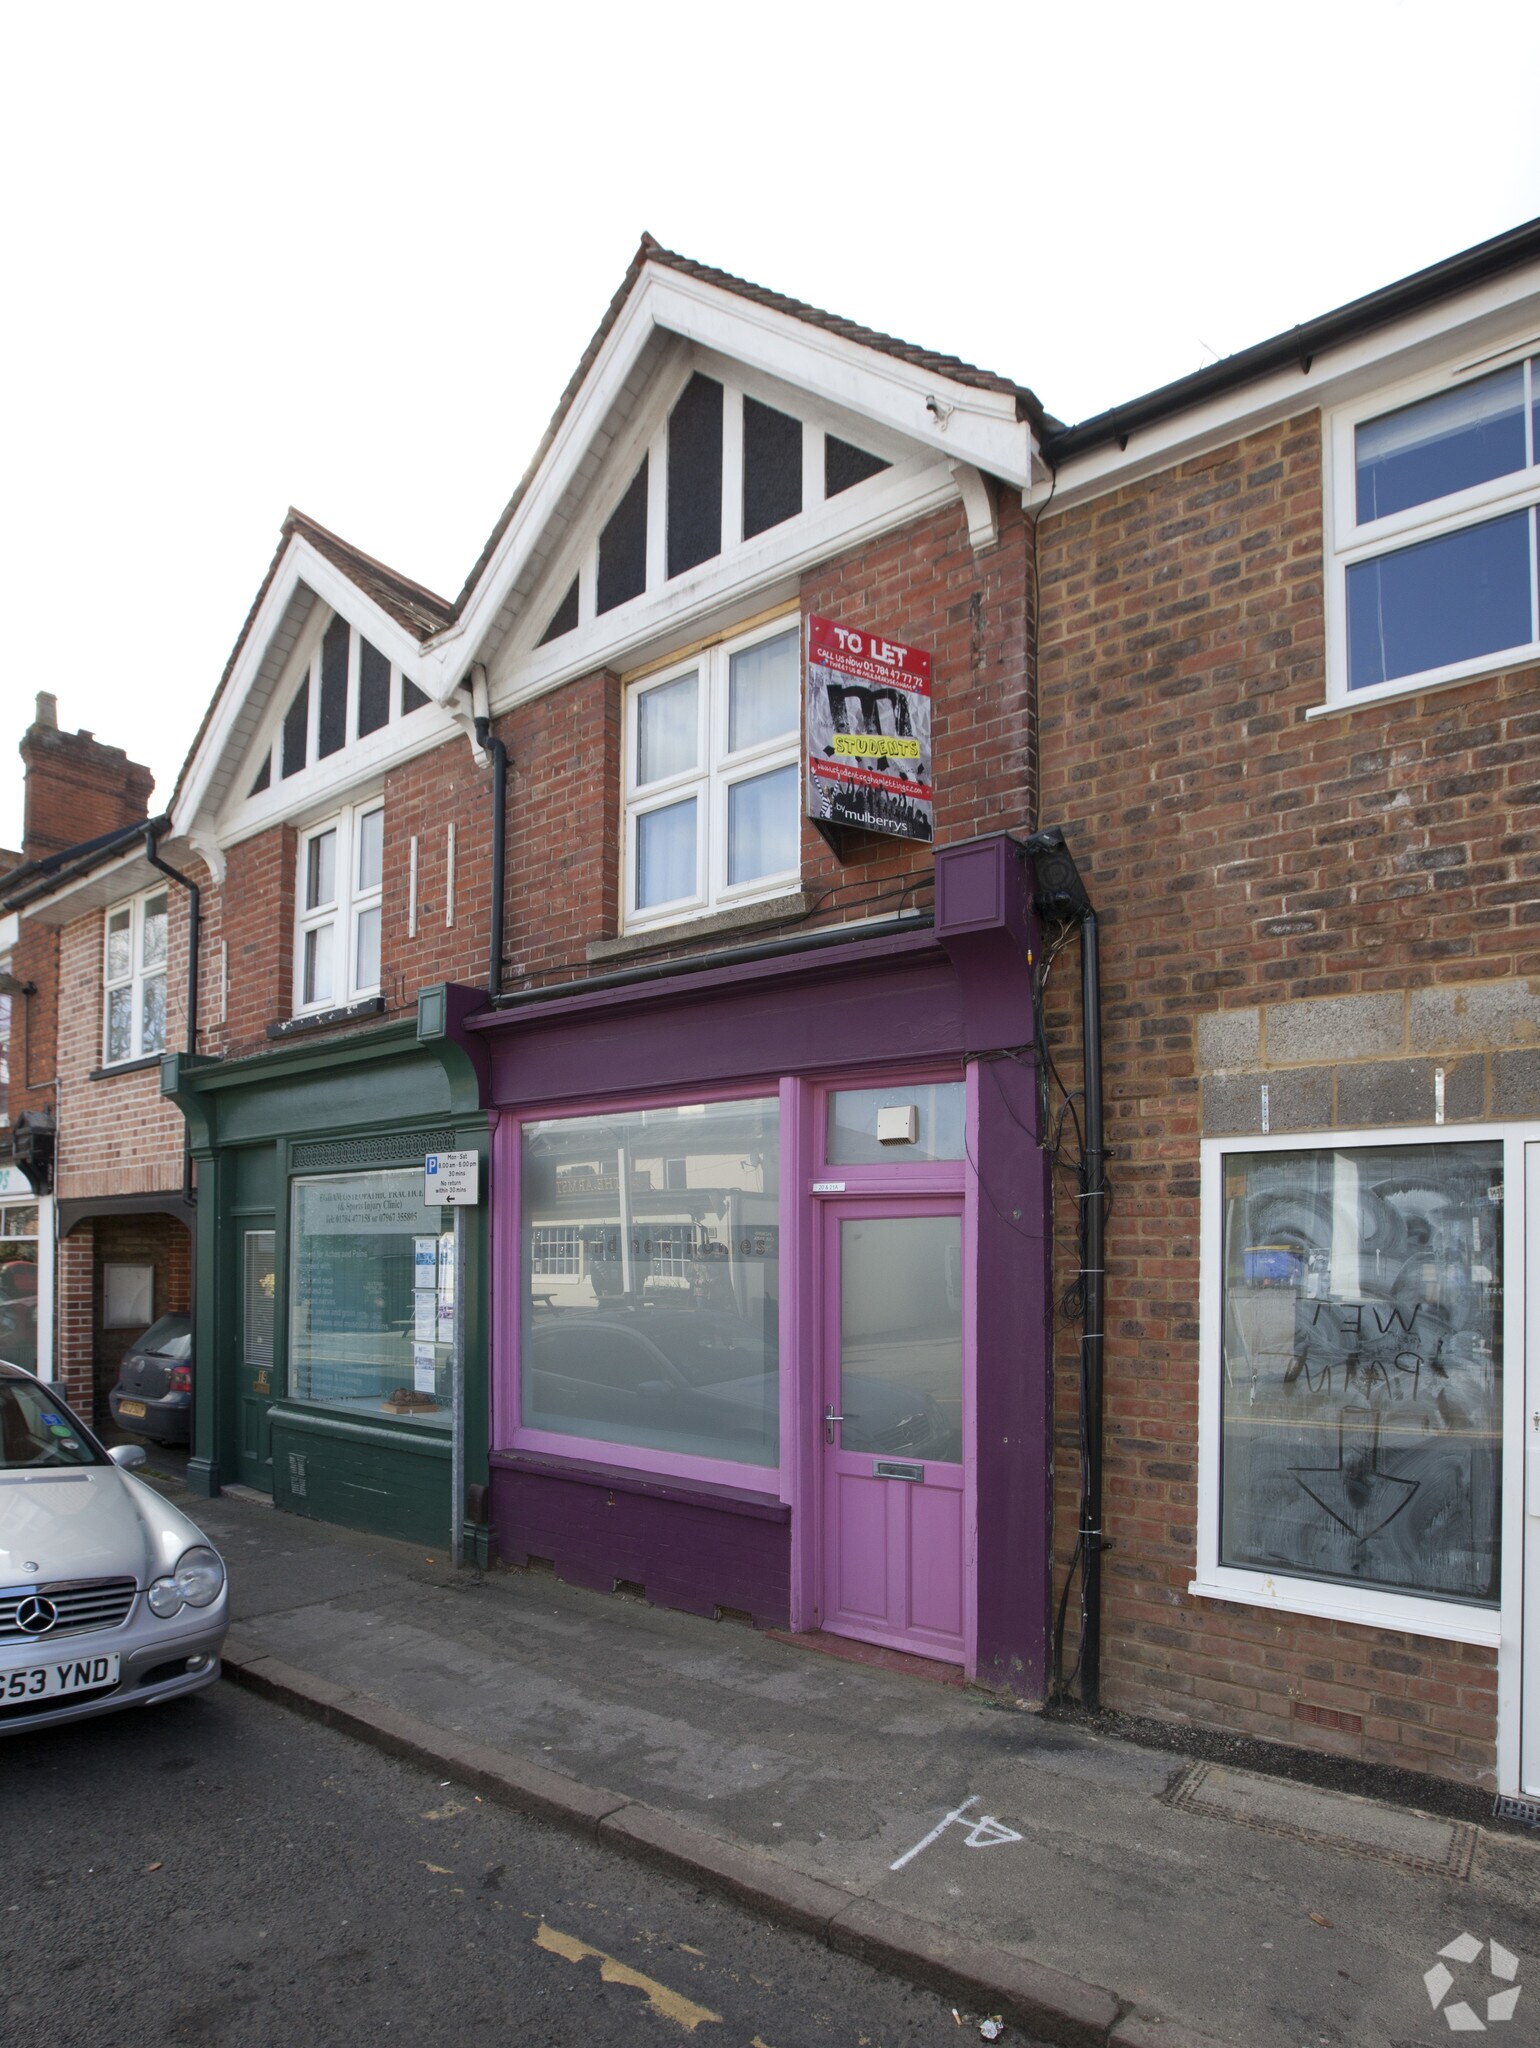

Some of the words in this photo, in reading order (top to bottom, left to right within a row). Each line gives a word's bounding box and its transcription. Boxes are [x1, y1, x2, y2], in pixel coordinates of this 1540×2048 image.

[834, 627, 863, 654] TO
[870, 638, 908, 667] LET
[817, 648, 833, 660] CALL
[836, 655, 845, 664] US
[846, 657, 862, 669] NOW
[890, 668, 900, 680] 47
[902, 672, 912, 684] 77
[913, 676, 923, 687] 72
[830, 661, 848, 671] TWEET
[835, 737, 919, 757] STUDENTS
[836, 803, 846, 813] by
[845, 810, 908, 832] mulberrys
[429, 1158, 436, 1173] P
[364, 1201, 381, 1212] Injury
[382, 1200, 402, 1210] Clinic)
[57, 1658, 108, 1689] YND
